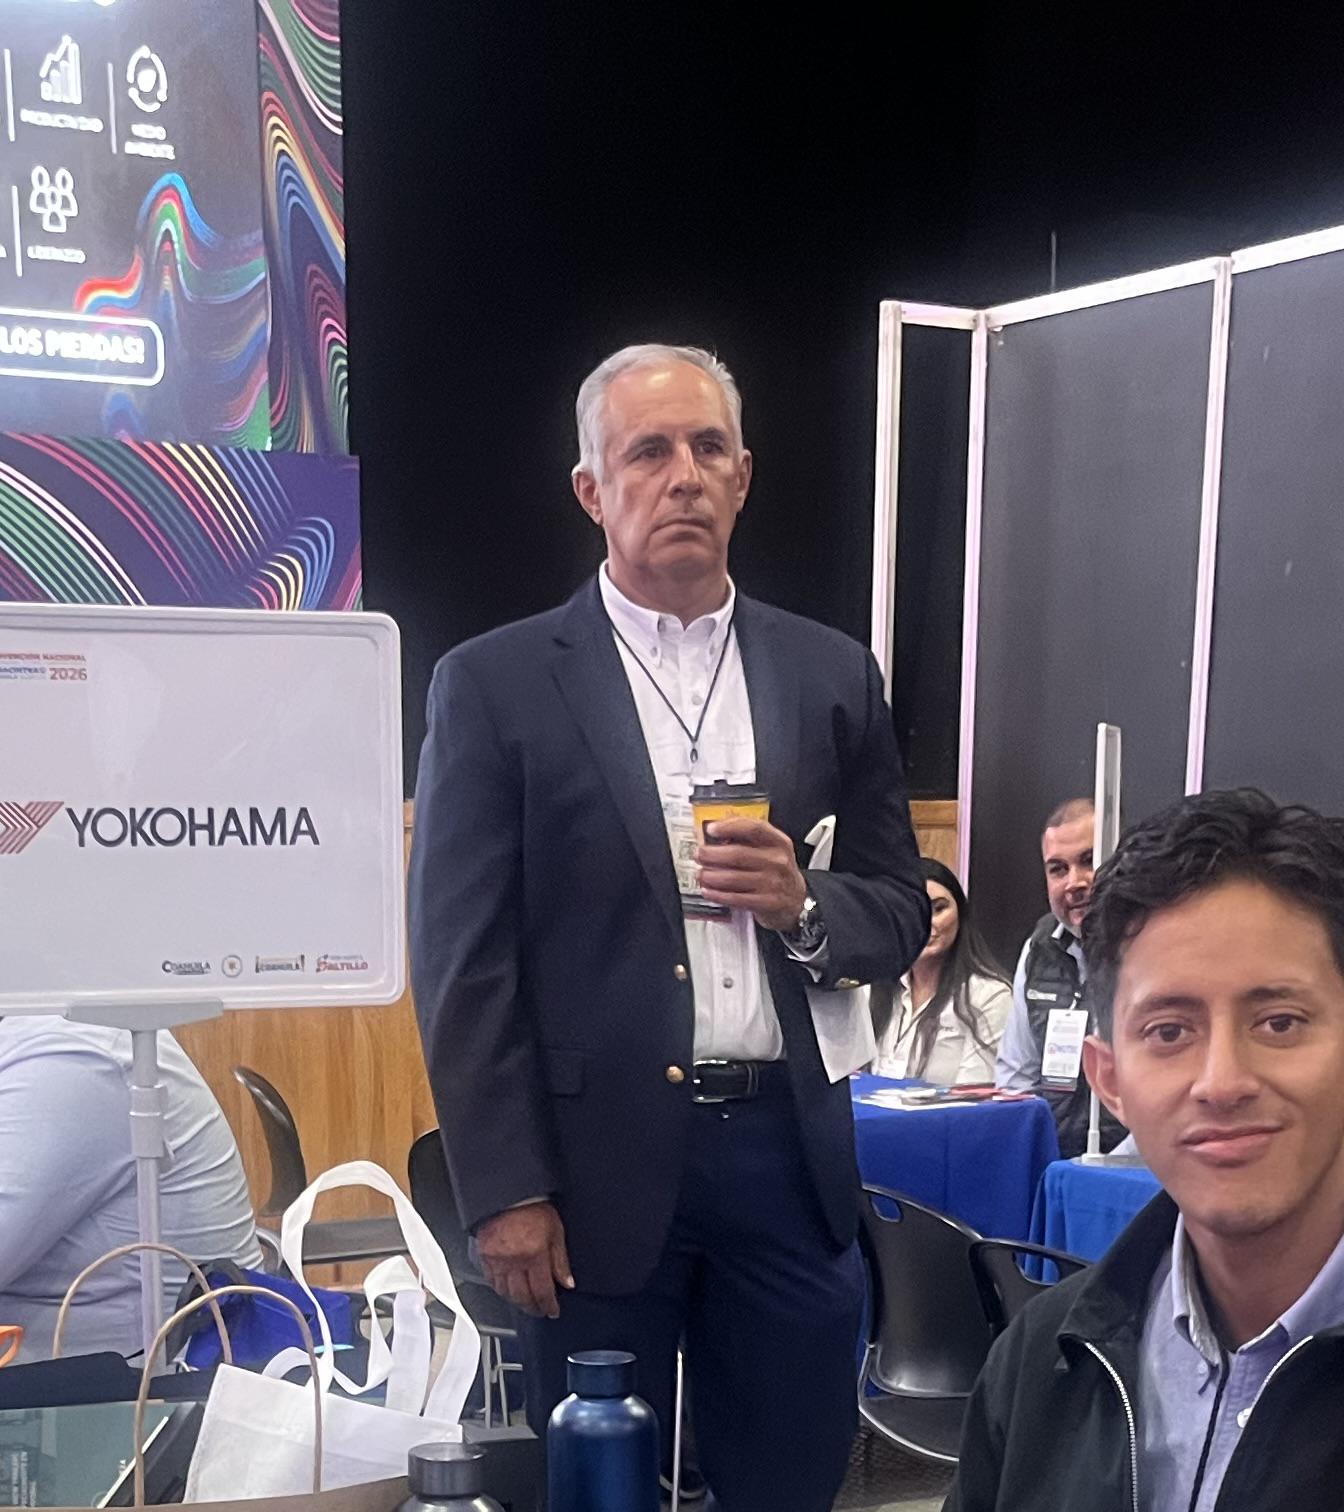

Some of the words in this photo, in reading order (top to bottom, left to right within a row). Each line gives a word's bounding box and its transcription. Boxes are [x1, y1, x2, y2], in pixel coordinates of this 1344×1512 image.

[45, 329, 145, 365] PIERDAS!
[49, 667, 88, 681] 2026
[65, 805, 321, 849] YOKOHAMA
